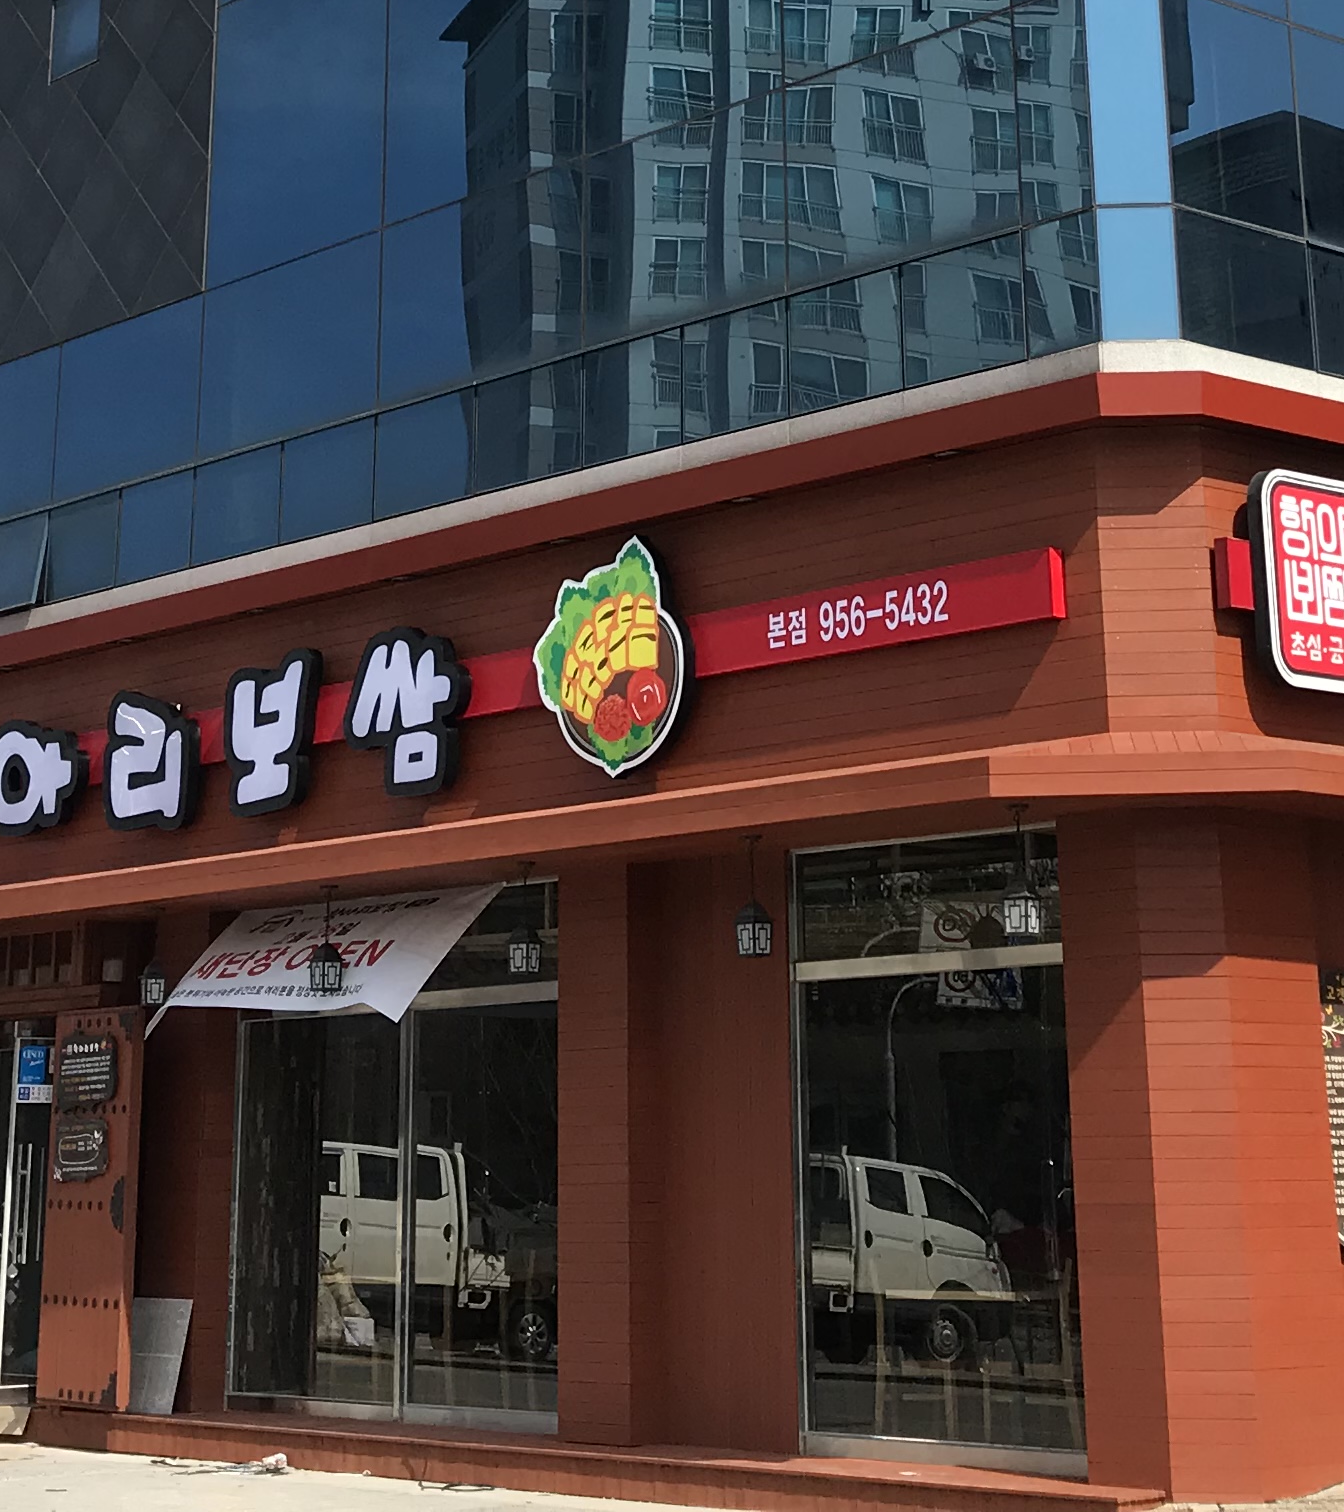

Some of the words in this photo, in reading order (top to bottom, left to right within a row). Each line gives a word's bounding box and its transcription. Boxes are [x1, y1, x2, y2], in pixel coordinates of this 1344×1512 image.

[767, 607, 806, 649] 본점
[819, 580, 949, 642] 956-5432
[189, 946, 291, 979] 새단장
[285, 940, 395, 971] OEN
